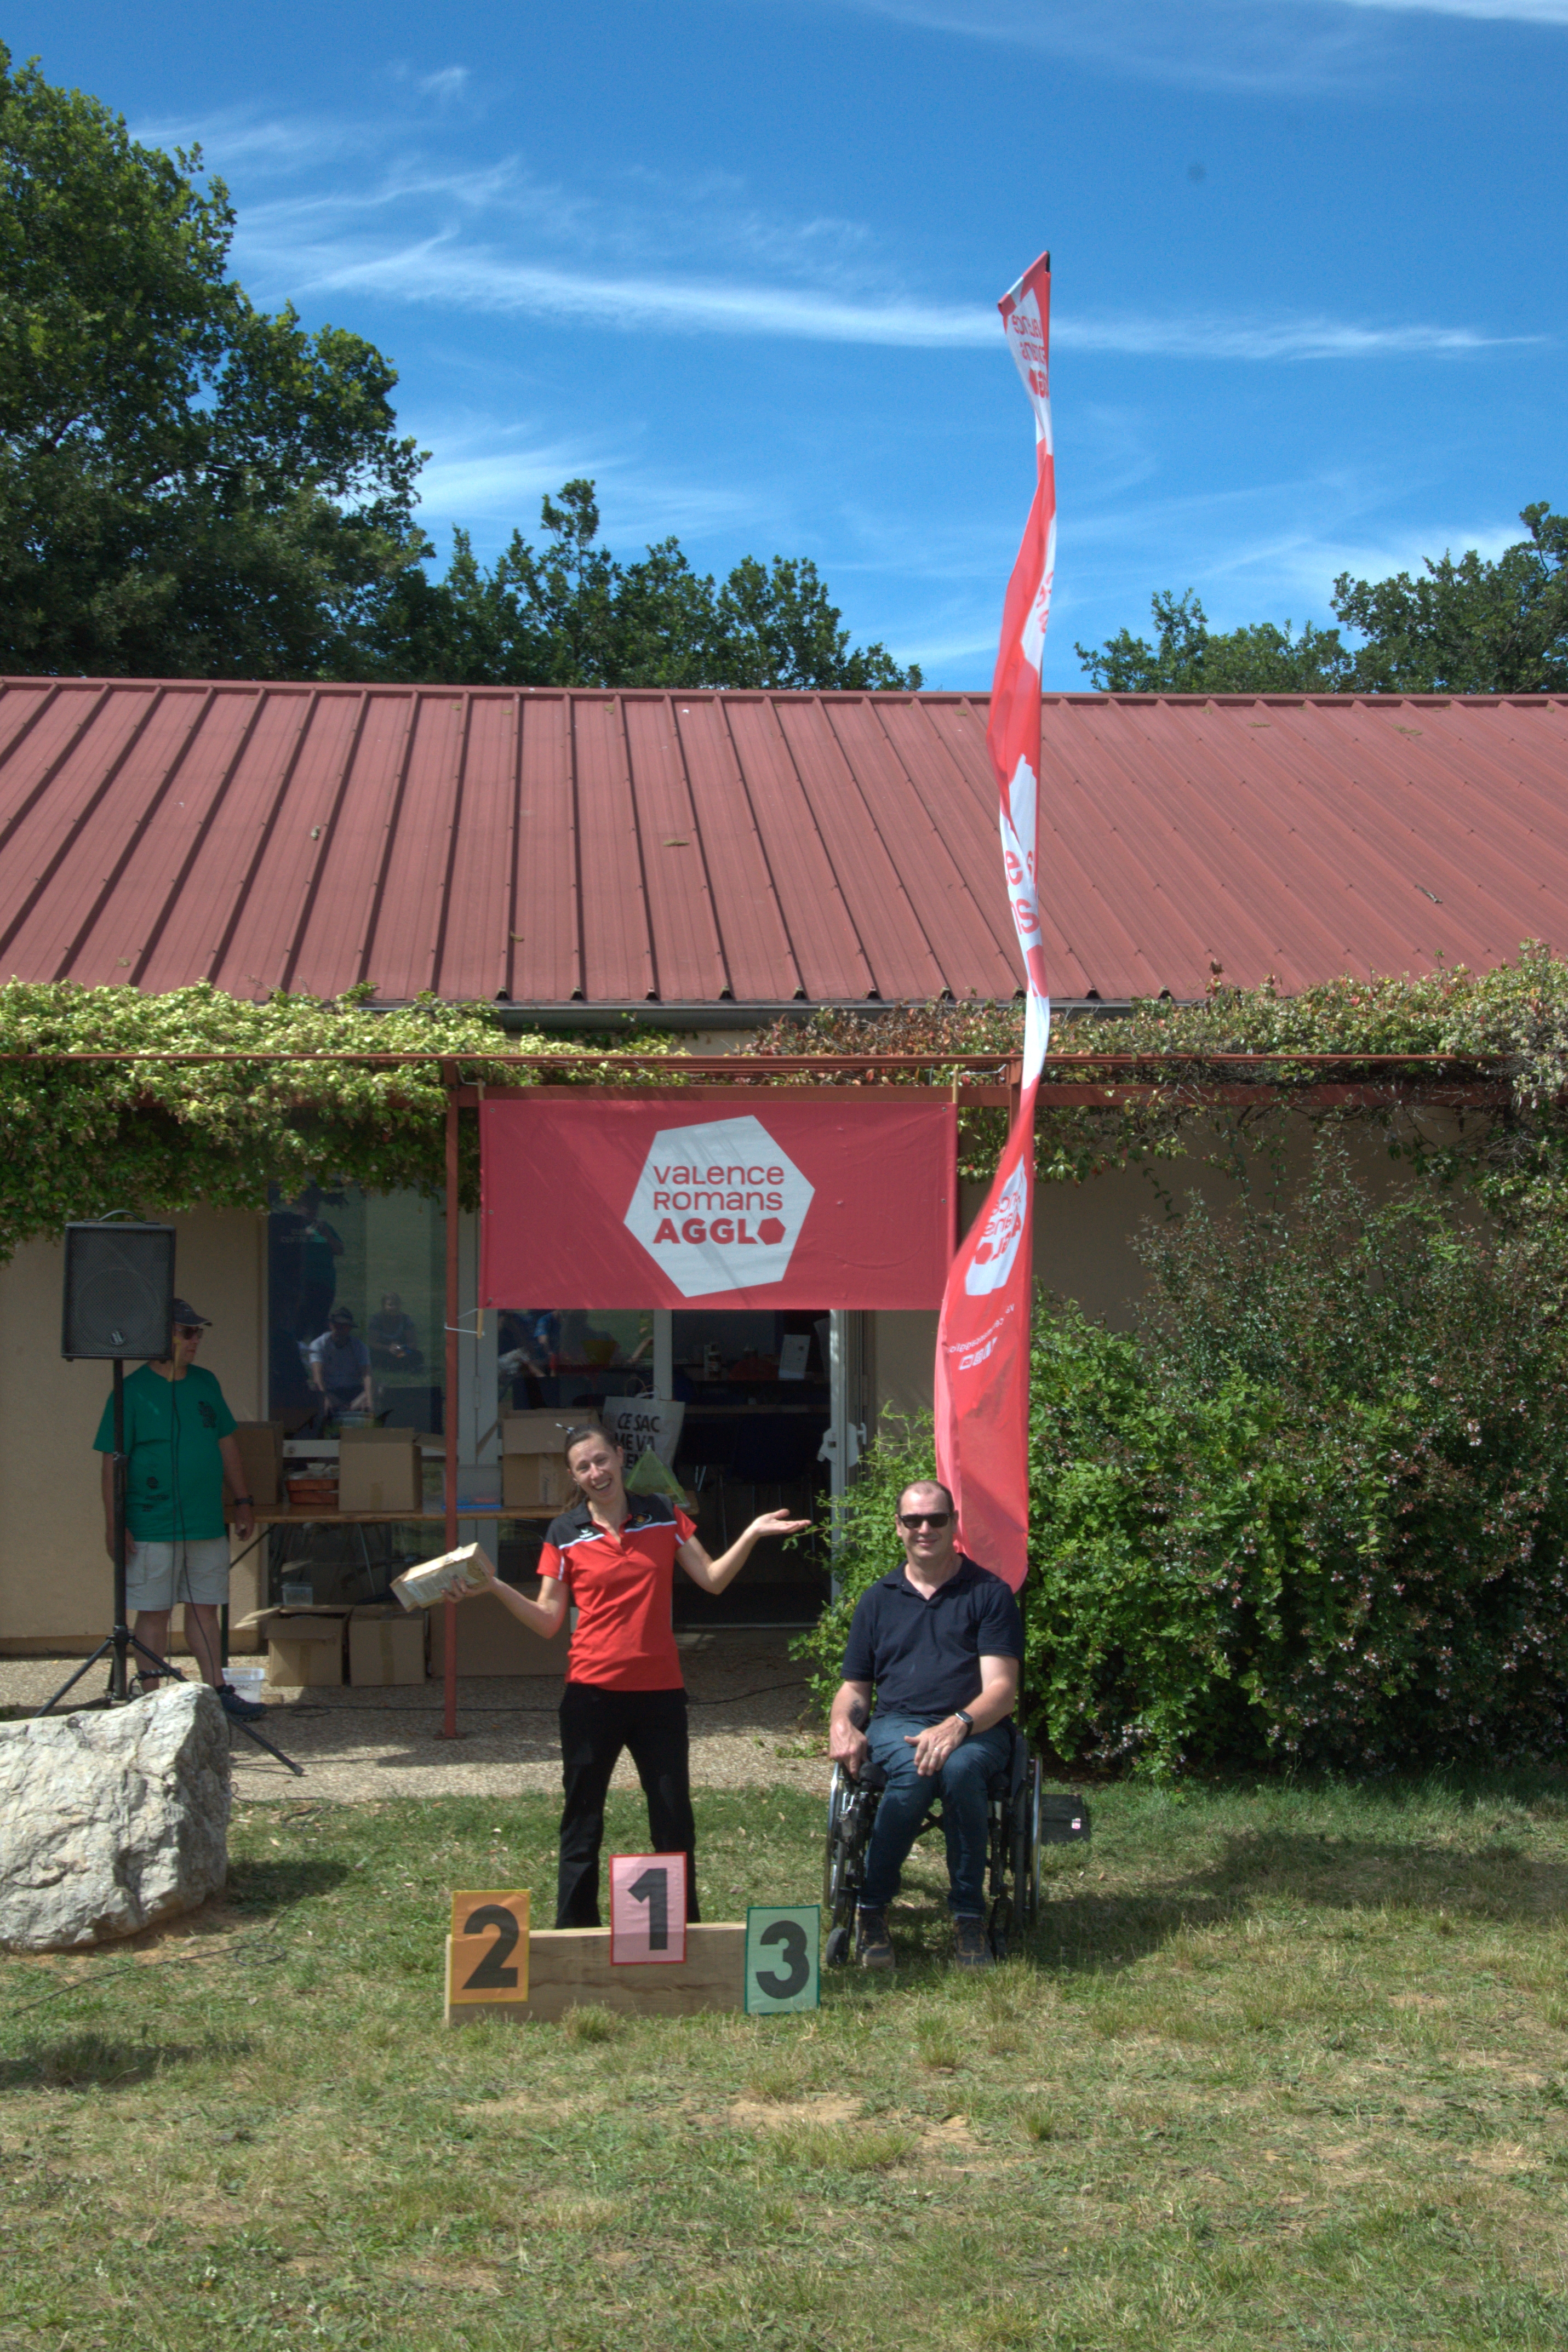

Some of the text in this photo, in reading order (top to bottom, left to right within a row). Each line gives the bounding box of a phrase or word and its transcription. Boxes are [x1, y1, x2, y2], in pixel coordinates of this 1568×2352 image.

[617, 1412, 660, 1433] CE SAC
[461, 1904, 519, 1990] 2
[627, 1868, 668, 1950] 1
[756, 1920, 810, 1999] 3
